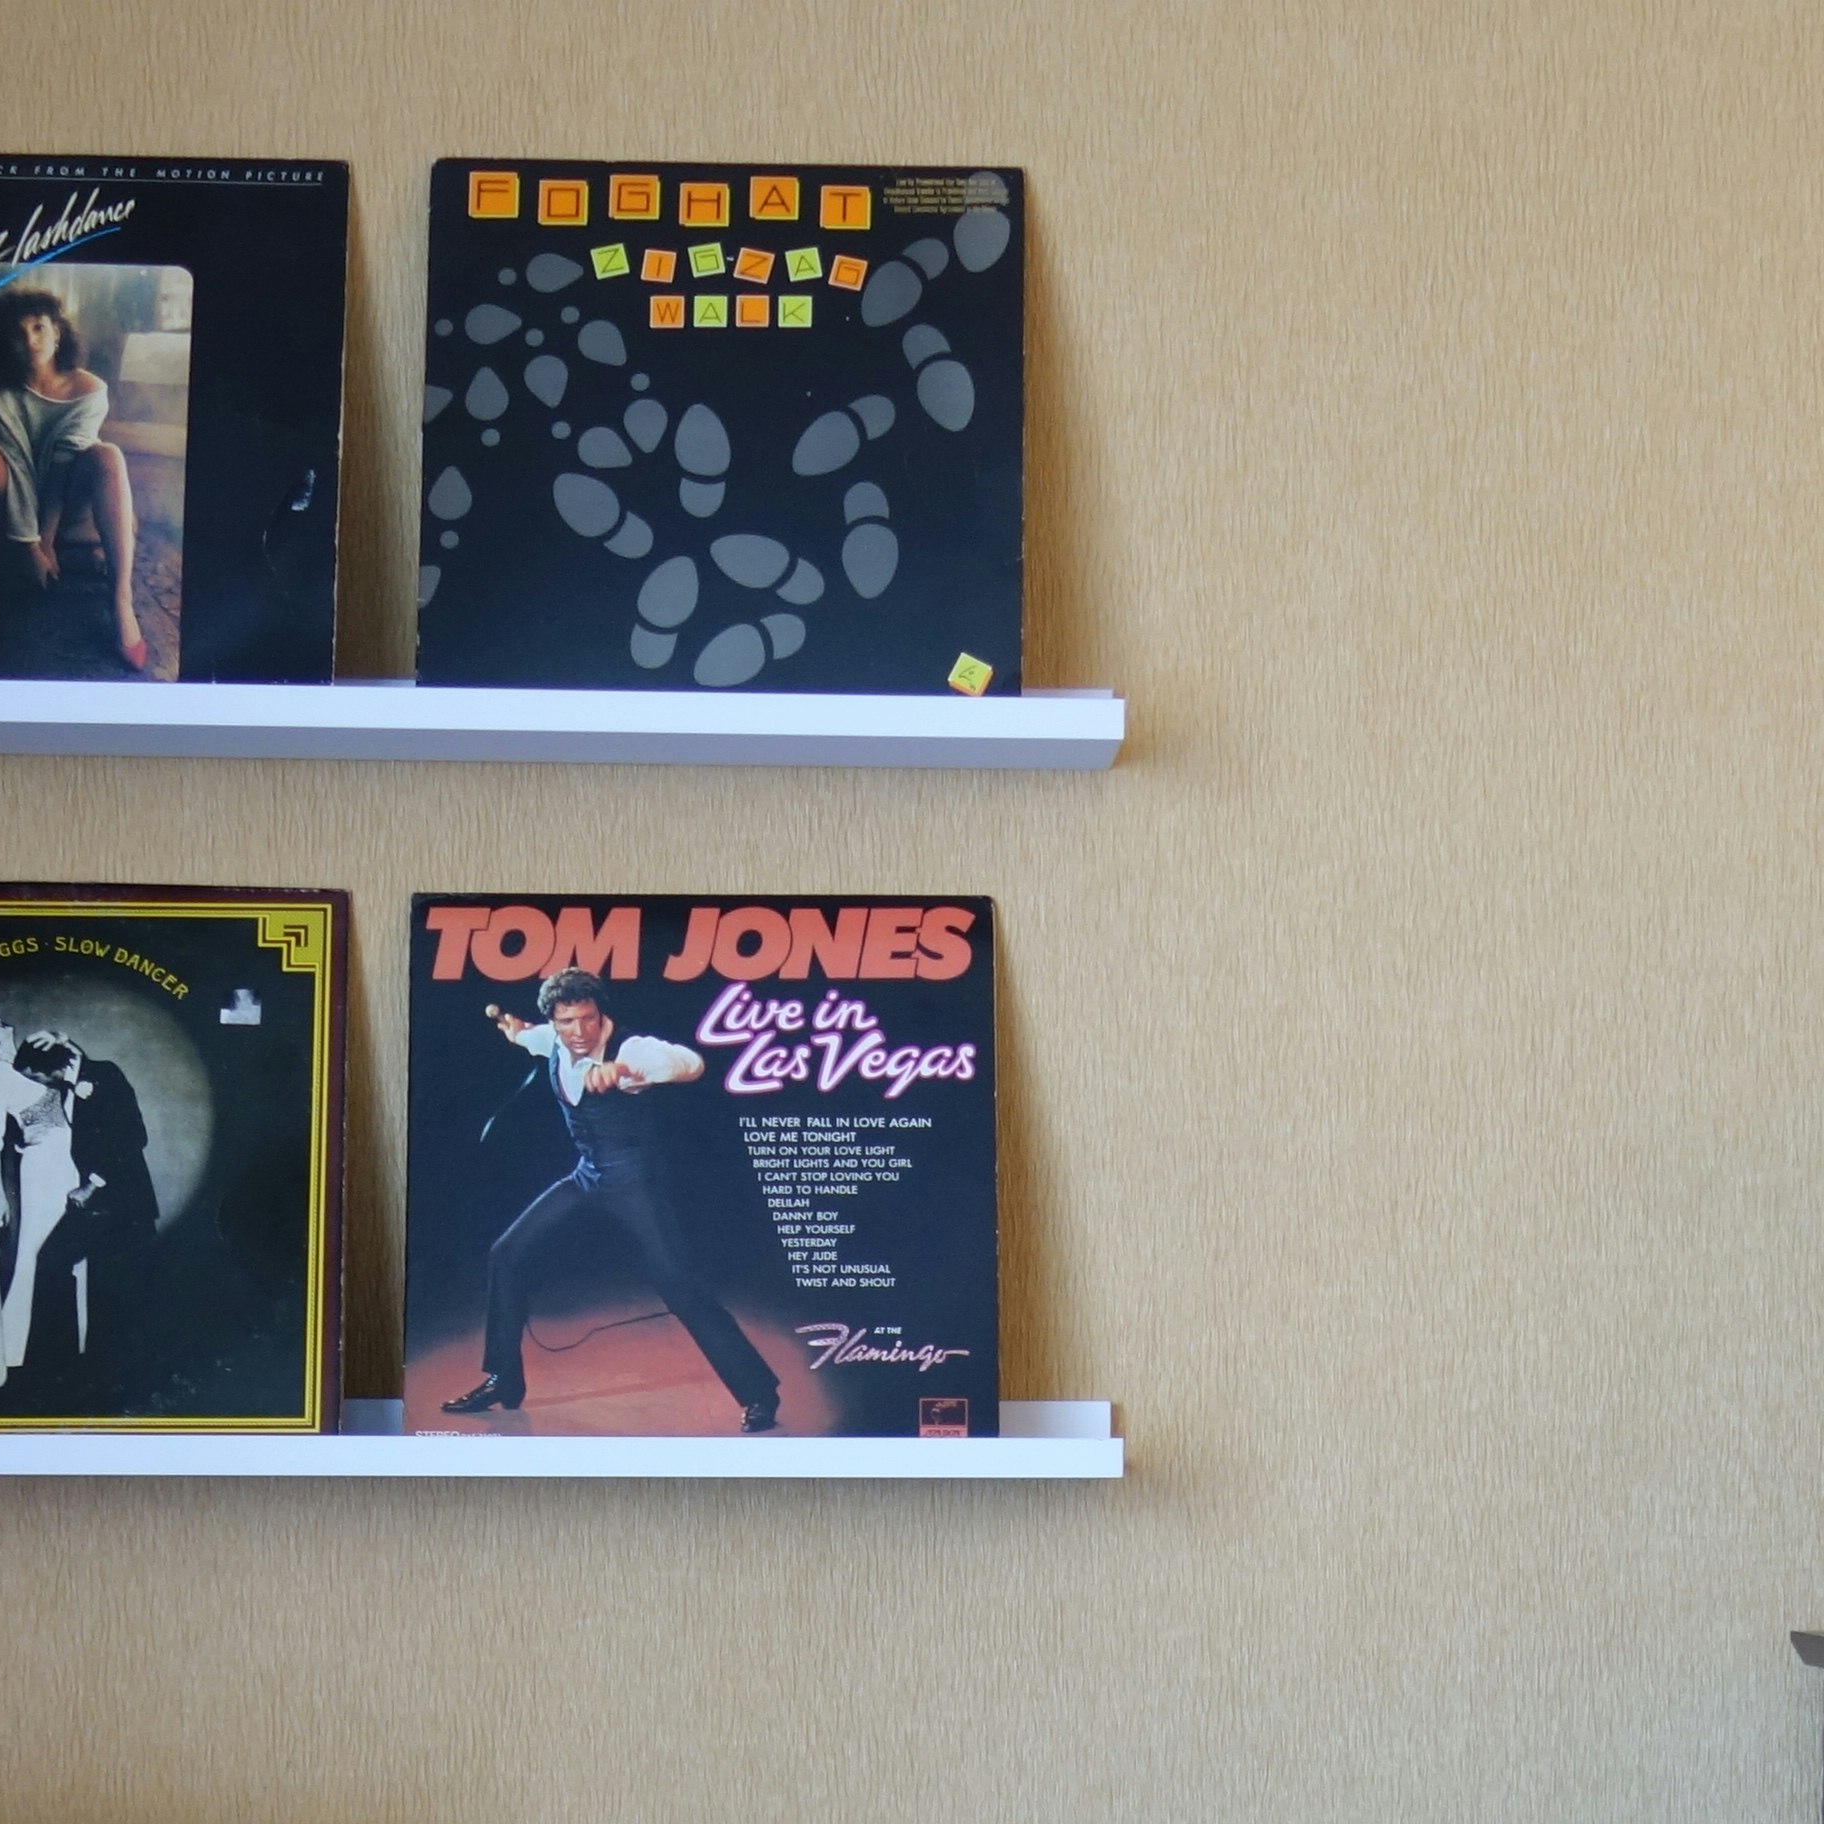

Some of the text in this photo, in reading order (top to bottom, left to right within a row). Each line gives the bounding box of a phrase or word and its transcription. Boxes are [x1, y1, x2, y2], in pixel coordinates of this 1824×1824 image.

[34, 166, 85, 176] FROM
[102, 167, 137, 177] THE
[156, 169, 231, 180] MOTION
[245, 171, 324, 182] PICTURE
[475, 178, 862, 224] FOGHAT
[654, 299, 808, 326] WALK
[426, 905, 976, 981] TOM JONES
[54, 935, 111, 958] SLOW
[113, 946, 190, 1000] DANCER
[697, 982, 877, 1045] Live in
[725, 1031, 976, 1098] Las Vegas
[739, 1117, 932, 1127] I'LL NEVER FALL IN LOVE AGAIN
[743, 1132, 856, 1142] LOVE ME TONIGHT
[747, 1146, 895, 1155] TURN ON YOUR LOVE LIGHT
[752, 1159, 913, 1168] BRIGHT LIGHTS AND YOU GIRL
[764, 1173, 797, 1181] CAN'T
[800, 1173, 828, 1181] STOP
[829, 1172, 873, 1181] LOVING
[875, 1172, 900, 1180] YOU
[762, 1185, 858, 1194] HARD TO HANDLE
[767, 1199, 810, 1207] DELILAH
[772, 1212, 839, 1220] DANNY BOY
[777, 1225, 856, 1233] HELP YOURSELF
[781, 1238, 837, 1247] YESTERDAY
[788, 1252, 838, 1260] HEY JUDE
[792, 1265, 891, 1273] IT'S NOT UNUSUAL
[795, 1278, 896, 1287] TWIST AND SHOUT
[873, 1326, 903, 1335] AT THE
[794, 1322, 970, 1372] Flamingo
